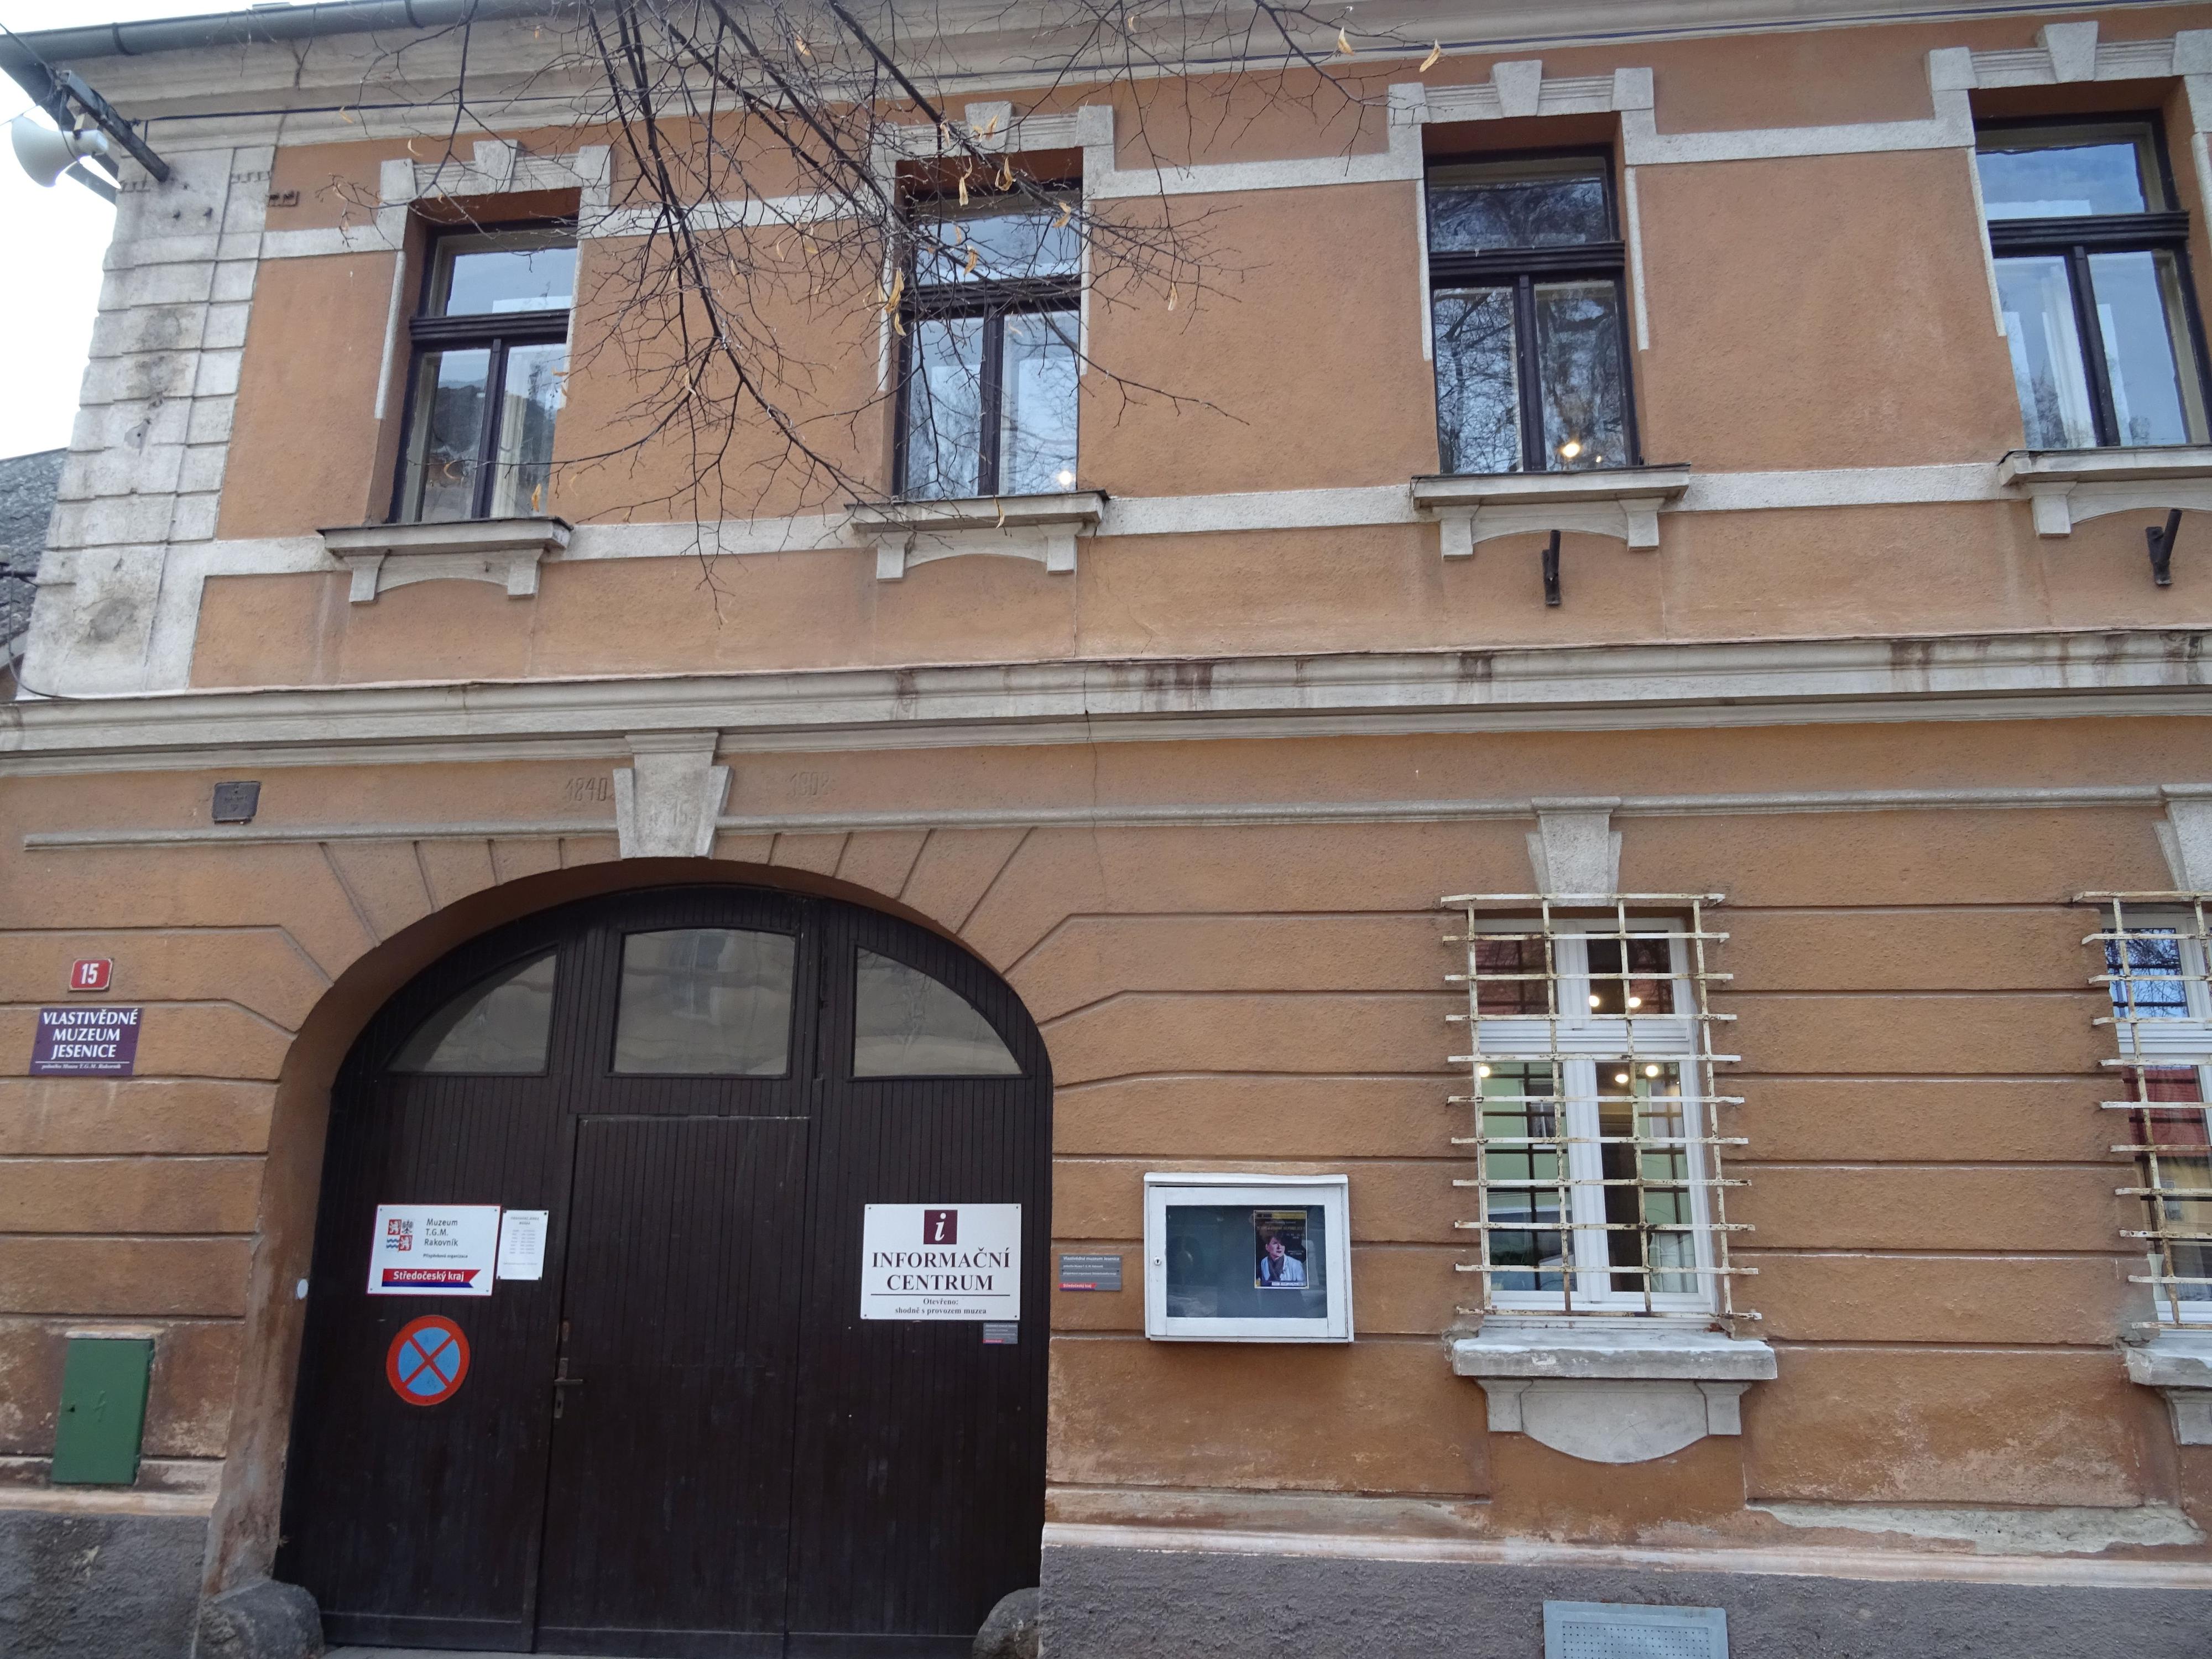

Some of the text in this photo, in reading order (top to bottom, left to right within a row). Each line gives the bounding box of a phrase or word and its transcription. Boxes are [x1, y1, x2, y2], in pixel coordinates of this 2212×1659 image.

[81, 963, 99, 984] 15
[43, 1009, 138, 1025] VLASTIVĚDNÉ
[53, 1028, 121, 1041] MUZEUM
[51, 1044, 117, 1060] JESENICE
[424, 1239, 458, 1247] Rakovník
[872, 1247, 1010, 1268] INFORMAČNÍ
[393, 1271, 464, 1282] Středočeský kraj
[886, 1275, 994, 1291] CENTRUM
